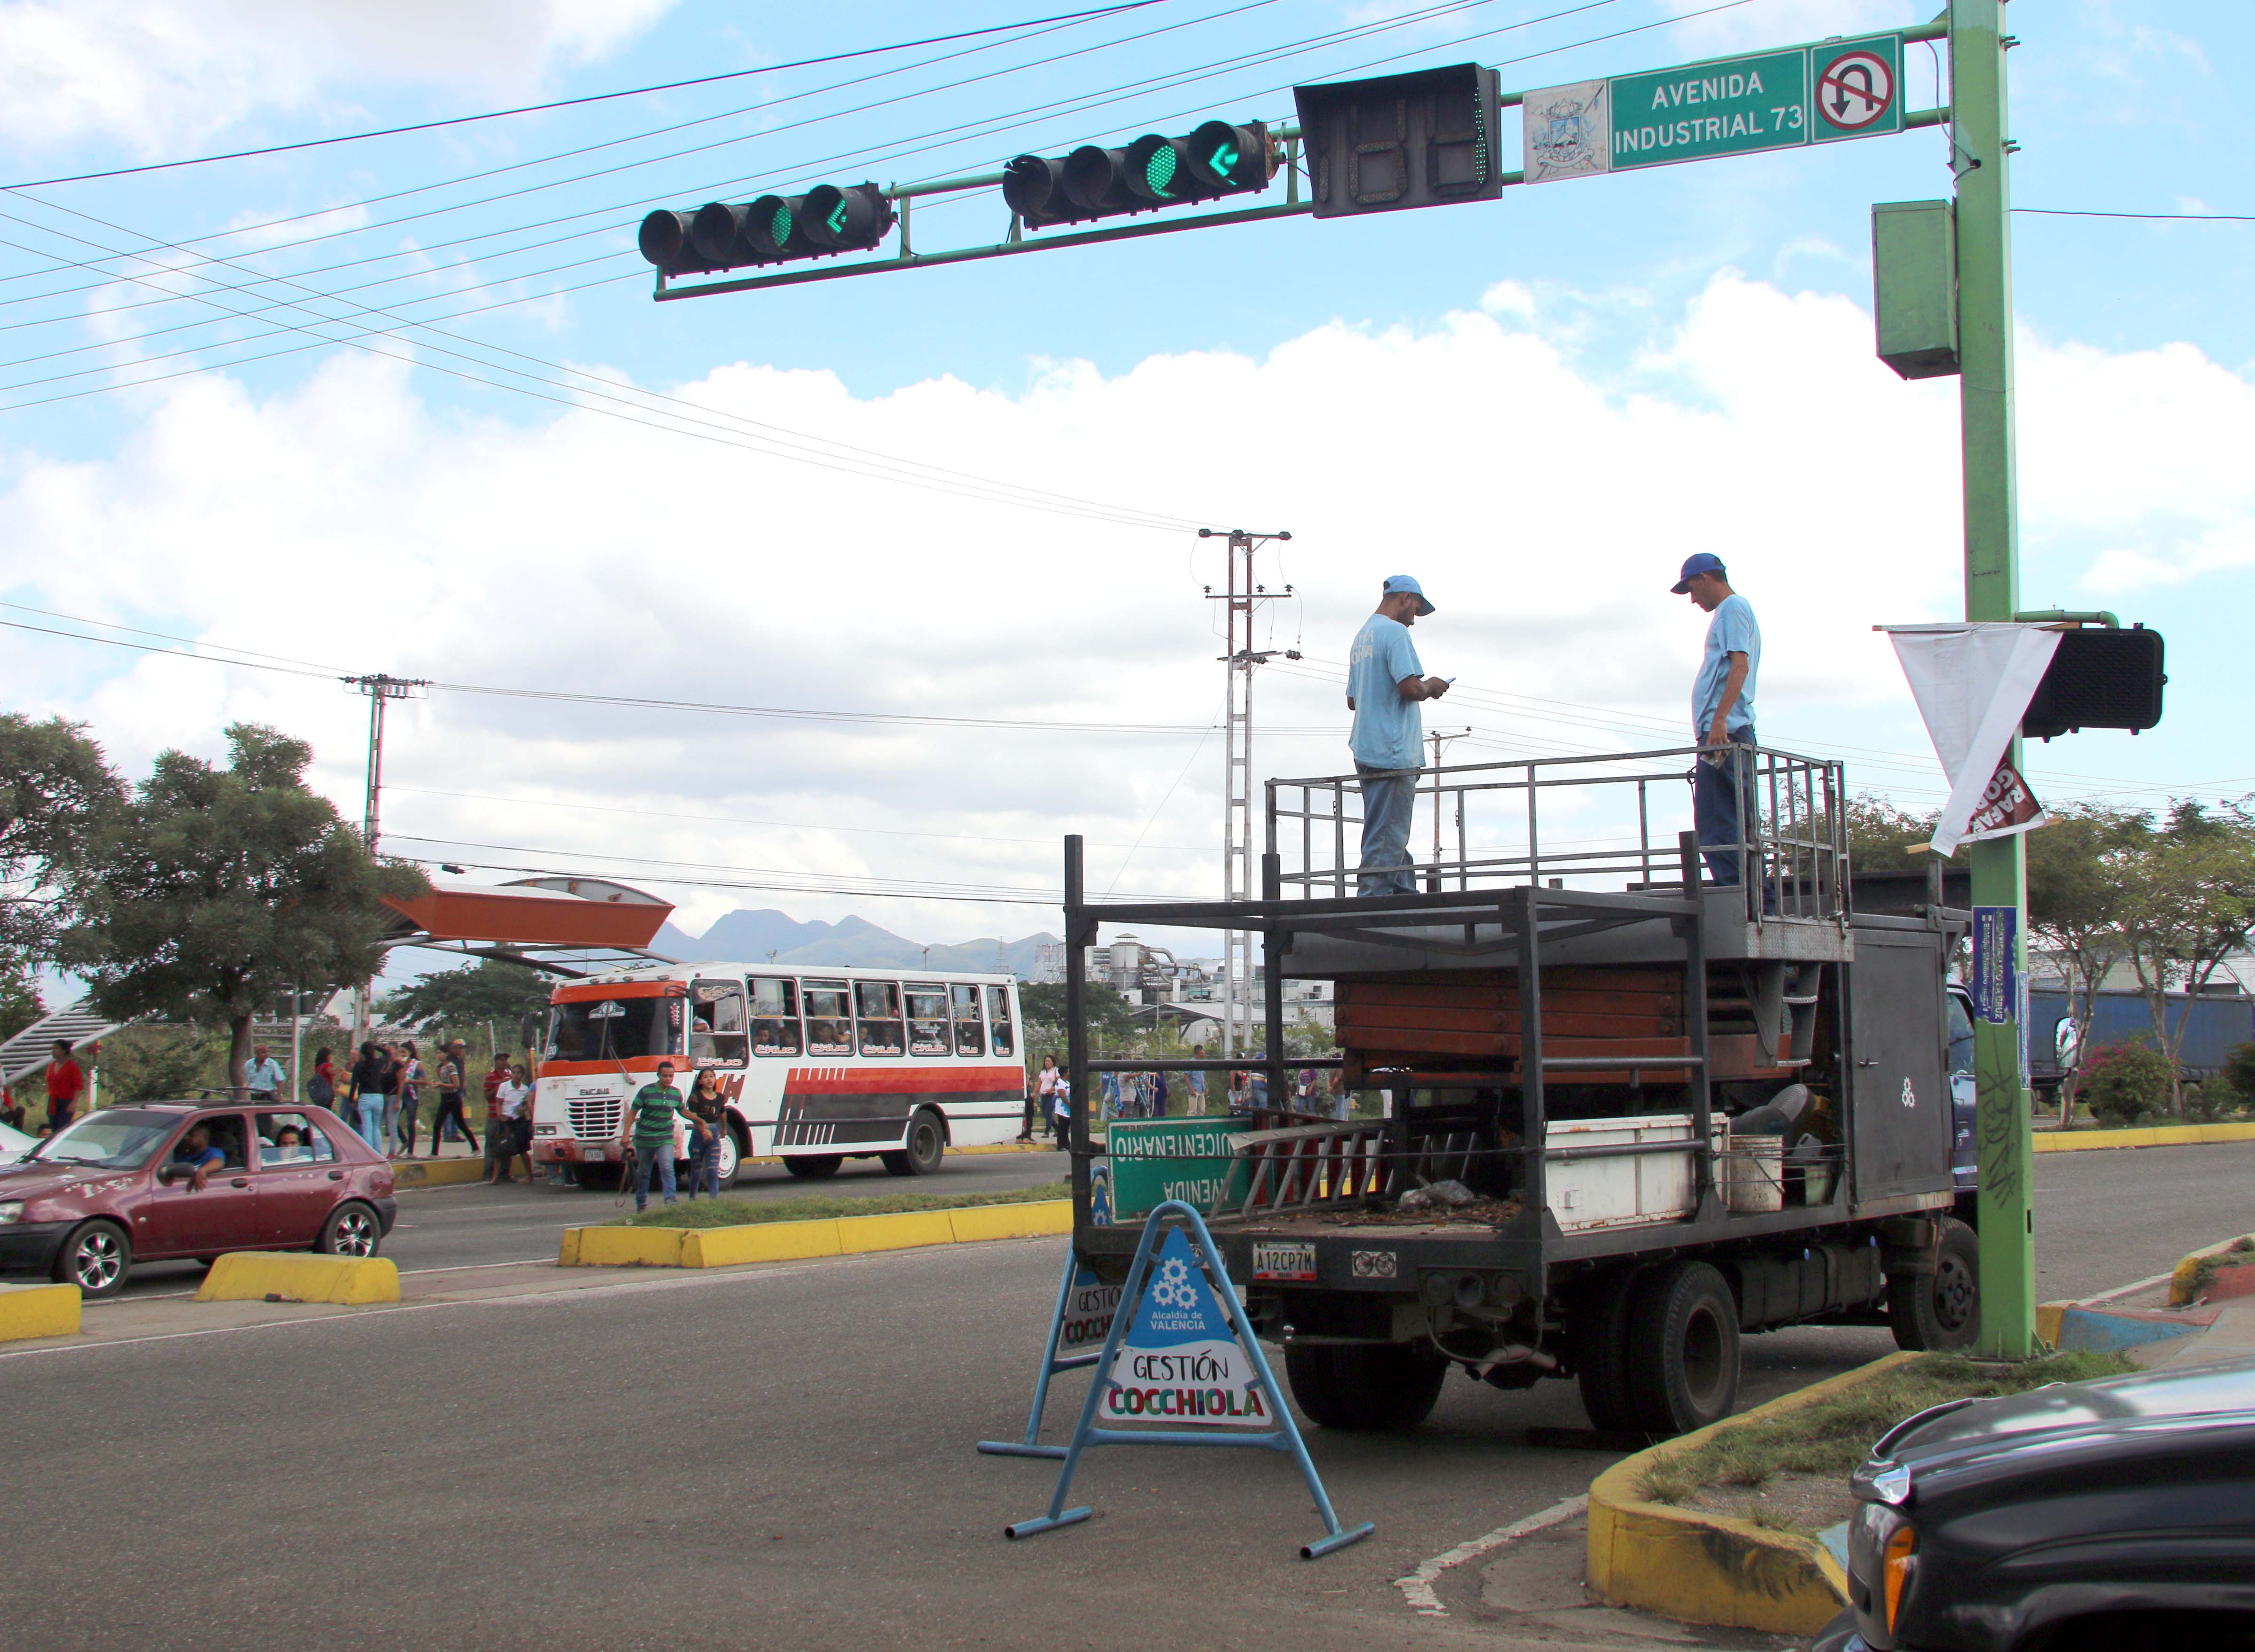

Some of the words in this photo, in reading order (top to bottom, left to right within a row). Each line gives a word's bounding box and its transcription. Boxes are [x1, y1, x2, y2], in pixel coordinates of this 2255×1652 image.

[1651, 71, 1764, 109] AVENIDA
[1615, 111, 1763, 154] INDUSTRIAL
[1770, 105, 1803, 132] 73
[548, 1046, 557, 1055] 20
[1257, 1251, 1312, 1271] A12CP7M
[1150, 1320, 1206, 1330] VALENCIA
[1152, 1310, 1188, 1319] Alcaldía
[1191, 1310, 1202, 1319] de
[1134, 1349, 1229, 1381] GESTIÓN
[1108, 1387, 1265, 1417] COCCHIOLA
